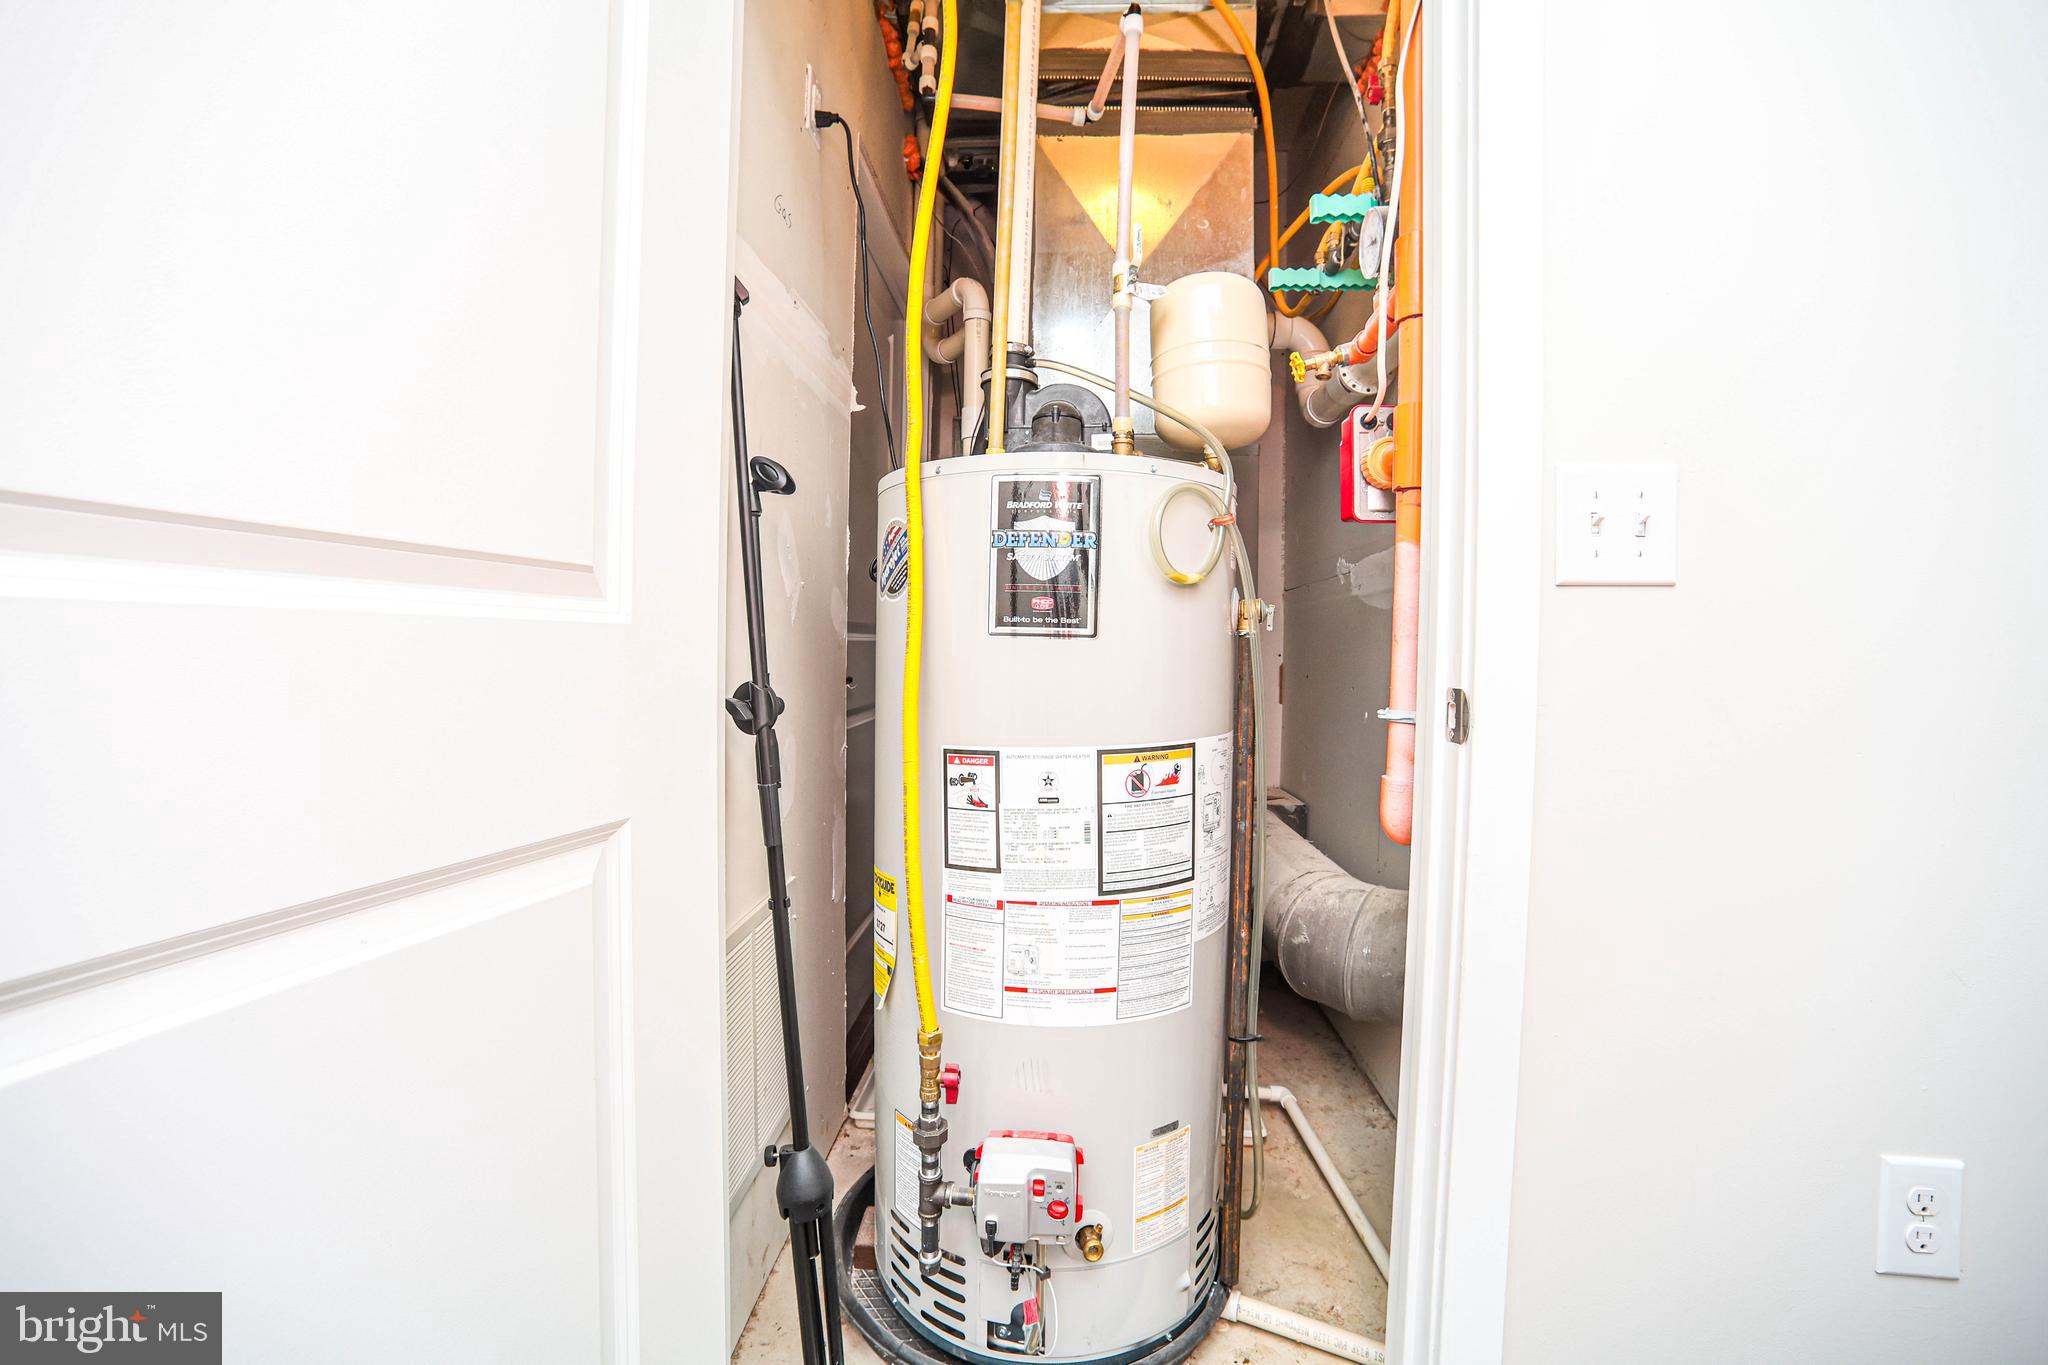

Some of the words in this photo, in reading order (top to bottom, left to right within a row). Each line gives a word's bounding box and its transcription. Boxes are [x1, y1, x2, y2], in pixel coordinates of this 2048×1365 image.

[774, 194, 792, 229] Gas
[1006, 501, 1052, 509] BRADFORD
[991, 529, 1098, 549] DEFENDER
